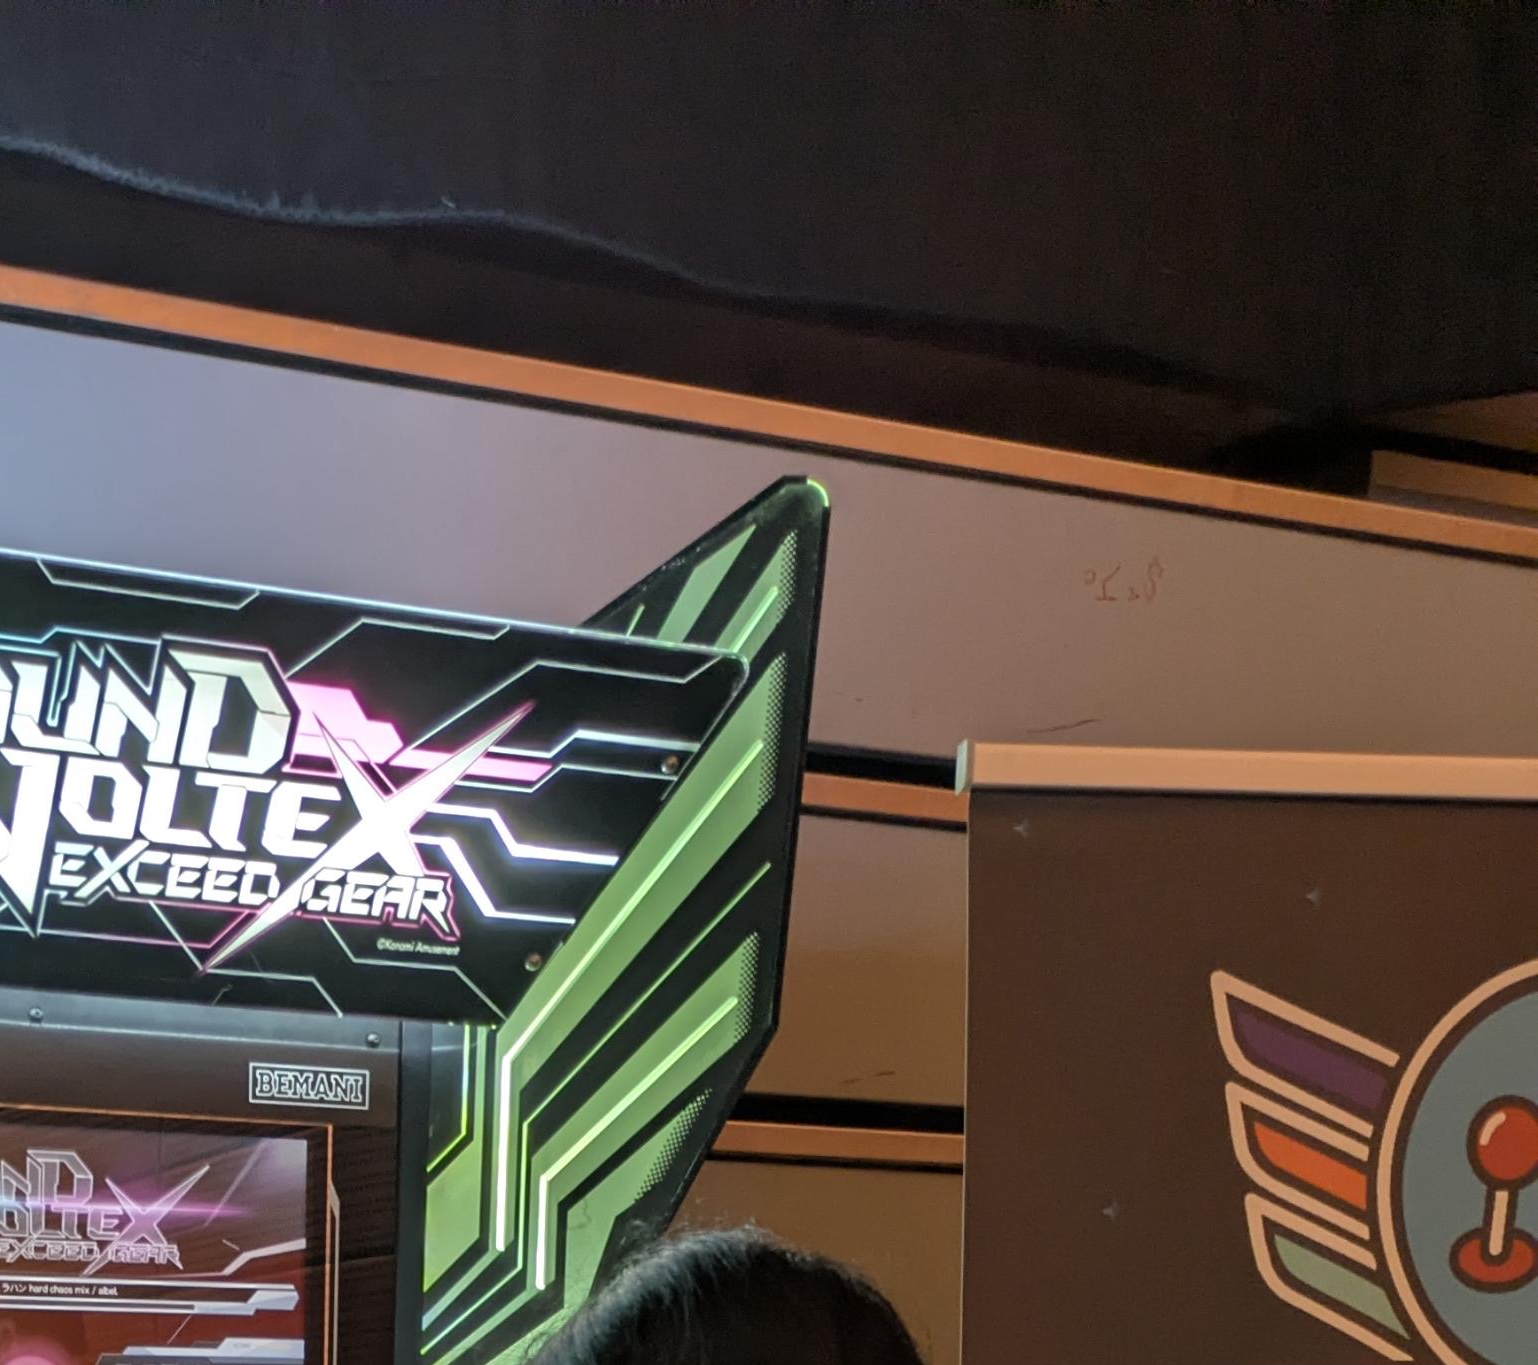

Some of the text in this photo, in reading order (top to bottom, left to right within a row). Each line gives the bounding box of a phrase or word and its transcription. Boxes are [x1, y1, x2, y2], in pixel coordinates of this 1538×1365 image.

[49, 840, 457, 932] EXCEED GEAR
[254, 1069, 365, 1104] BEMANI
[107, 1243, 183, 1268] GEAR
[28, 1284, 49, 1295] hard
[74, 1286, 90, 1296] mix
